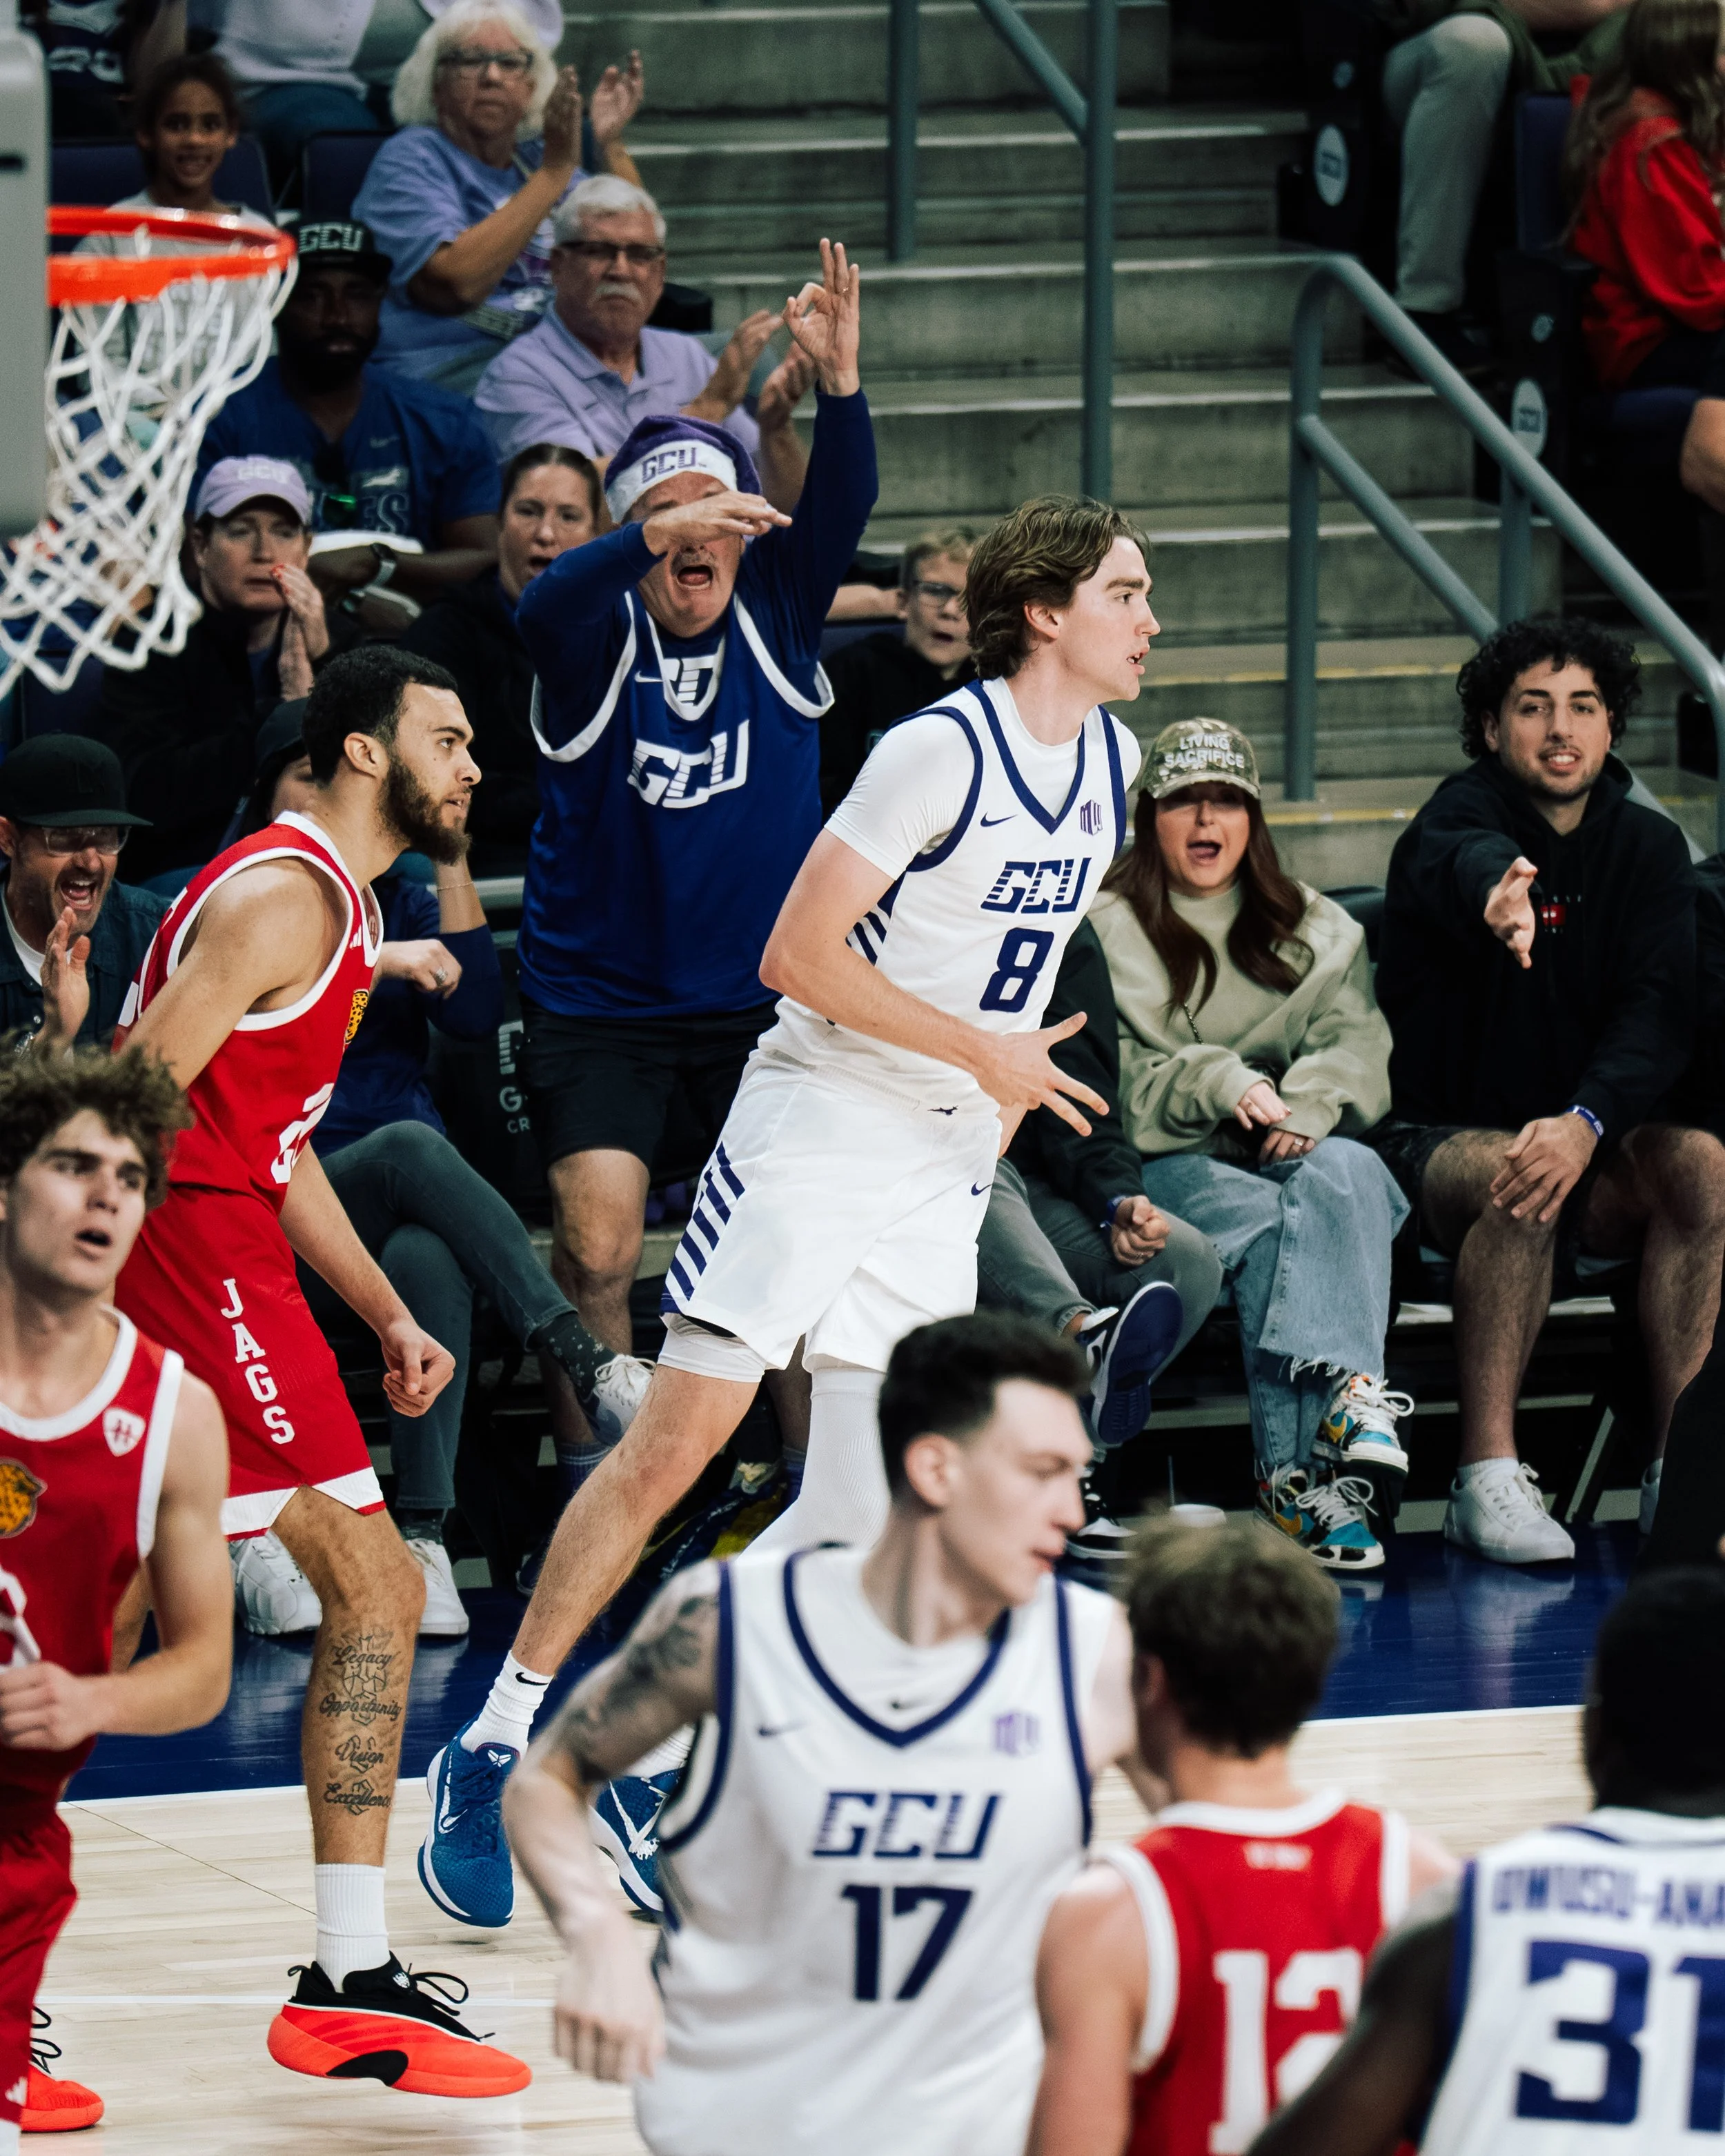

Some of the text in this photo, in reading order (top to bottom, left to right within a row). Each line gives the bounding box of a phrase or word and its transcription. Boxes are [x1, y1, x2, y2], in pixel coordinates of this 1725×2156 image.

[299, 222, 364, 253] GCU
[641, 446, 697, 484] GCU
[627, 719, 750, 809] GCU
[1164, 748, 1245, 769] SACRIFICE
[1179, 733, 1230, 751] LIVING
[980, 856, 1093, 915] GCU
[978, 927, 1055, 1013] 8
[220, 1278, 295, 1445] JAGS
[809, 1789, 1003, 1862] GCU
[838, 1881, 976, 2004] 17
[1210, 1947, 1364, 2156] 12
[1511, 1938, 1725, 2135] 31
